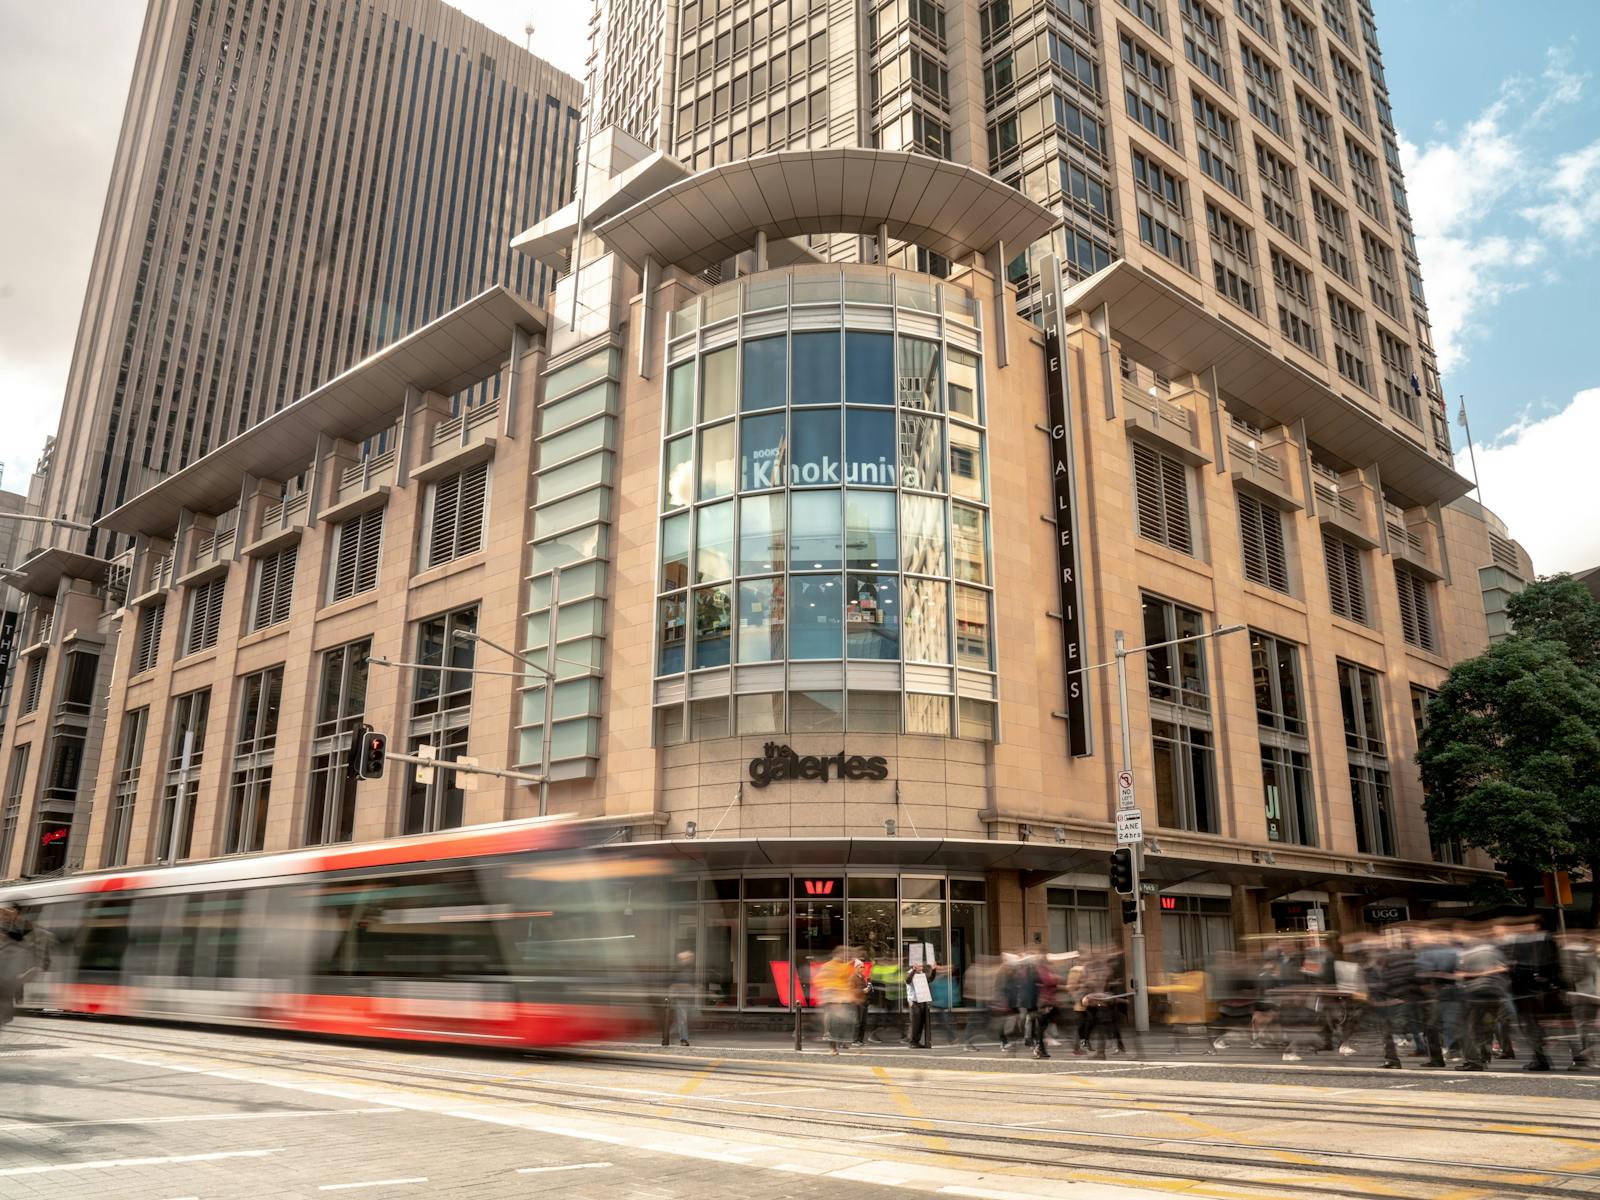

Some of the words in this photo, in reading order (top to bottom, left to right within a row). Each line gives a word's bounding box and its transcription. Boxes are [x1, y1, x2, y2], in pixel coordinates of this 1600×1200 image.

[753, 448, 780, 459] BOOKS
[753, 455, 919, 489] Kinokuniya
[1045, 293, 1058, 372] THE
[1052, 424, 1080, 698] GALERIES
[763, 741, 798, 758] the
[749, 750, 888, 788] galeries
[1122, 788, 1131, 796] NO
[1119, 823, 1139, 831] LANE
[1119, 832, 1141, 840] 24hrs
[1371, 909, 1398, 918] UGG
